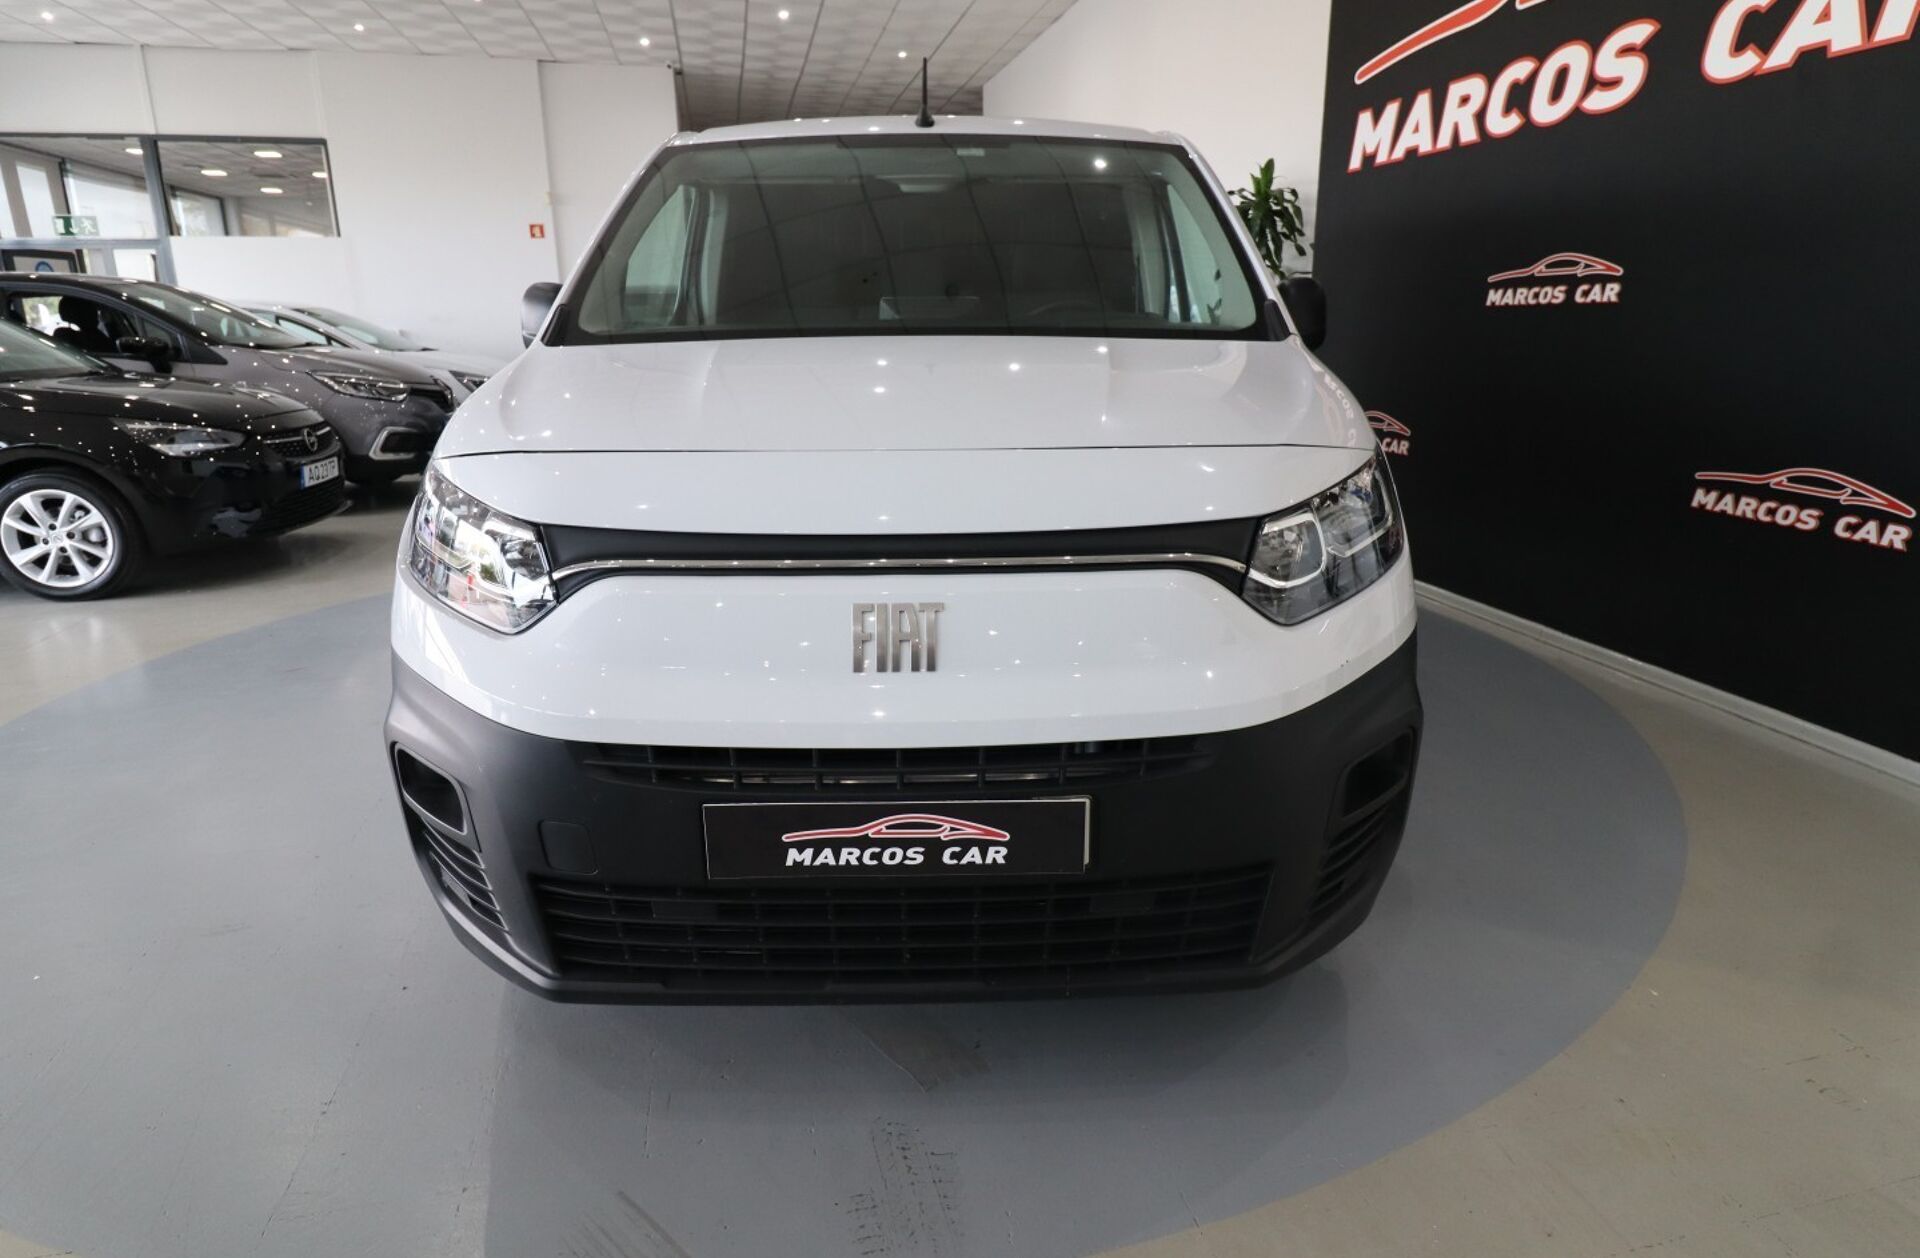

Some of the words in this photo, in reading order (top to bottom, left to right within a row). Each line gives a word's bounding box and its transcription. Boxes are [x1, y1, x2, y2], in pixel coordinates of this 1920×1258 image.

[1347, 18, 1661, 173] MARCOS
[1485, 284, 1568, 307] MARCOS
[1574, 282, 1622, 304] CAR
[1381, 437, 1410, 456] CAR
[1690, 487, 1824, 531] MARCOS
[1834, 515, 1912, 552] CAR
[851, 602, 945, 673] FIAT
[785, 846, 926, 867] MARCOS
[942, 846, 1009, 865] CAR
